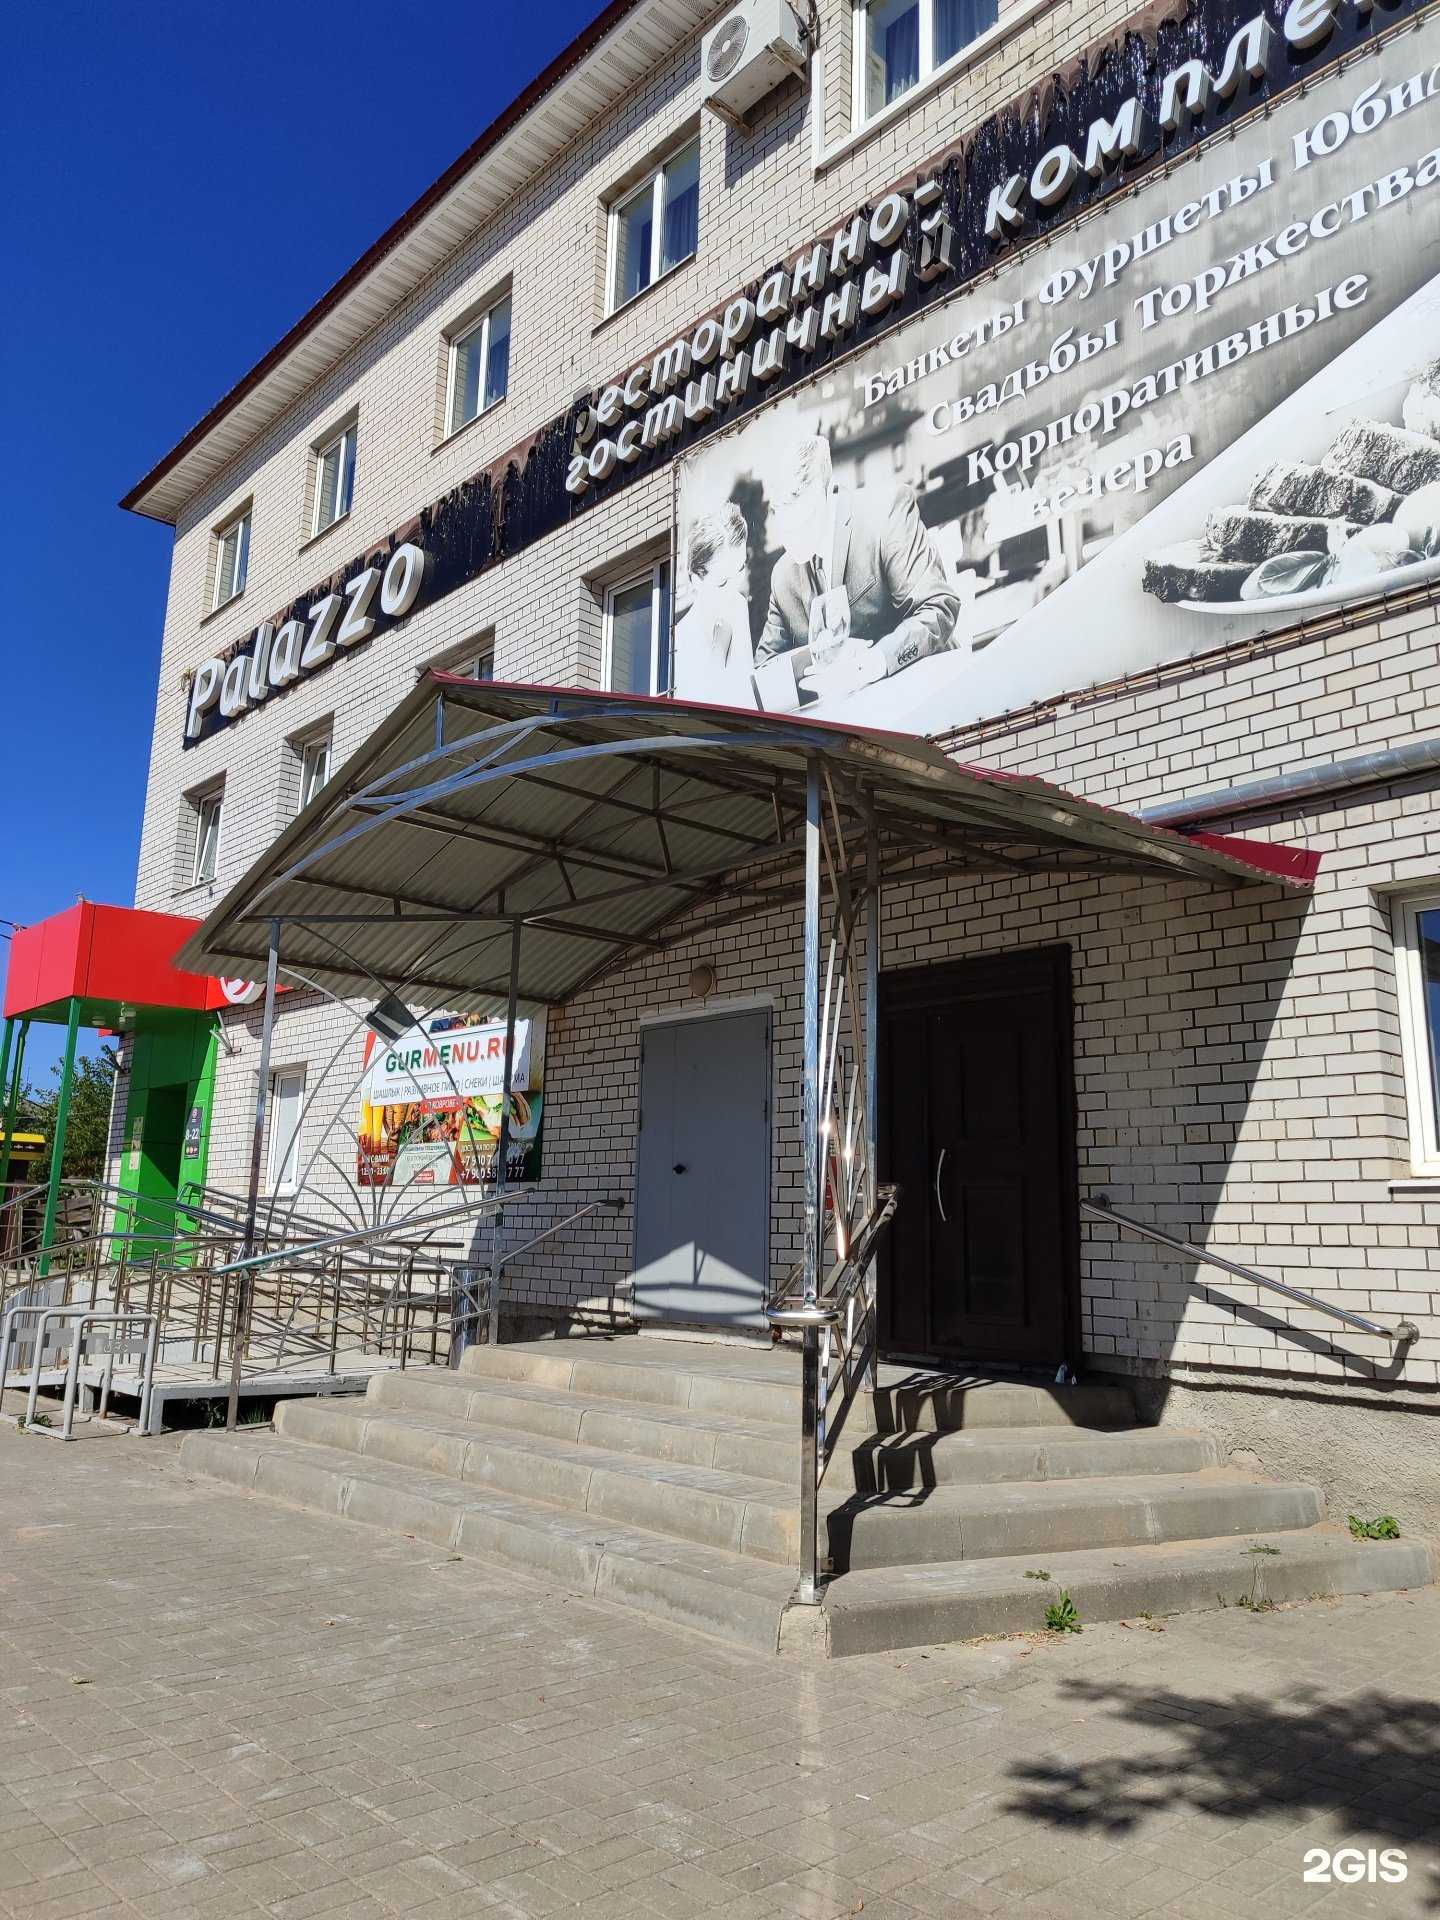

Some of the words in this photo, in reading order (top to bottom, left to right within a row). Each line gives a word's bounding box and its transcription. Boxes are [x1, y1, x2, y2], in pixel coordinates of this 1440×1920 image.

[983, 0, 1375, 238] компле
[565, 210, 953, 495] гостиничный
[862, 300, 1026, 409] Банкеты
[1037, 157, 1274, 305] Фуршеты
[924, 319, 1120, 437] Свадьбы
[1133, 147, 1440, 334] Торжества
[966, 273, 1370, 488] Корпоративные
[1029, 432, 1195, 521] вечера
[186, 542, 425, 739] Palazzo
